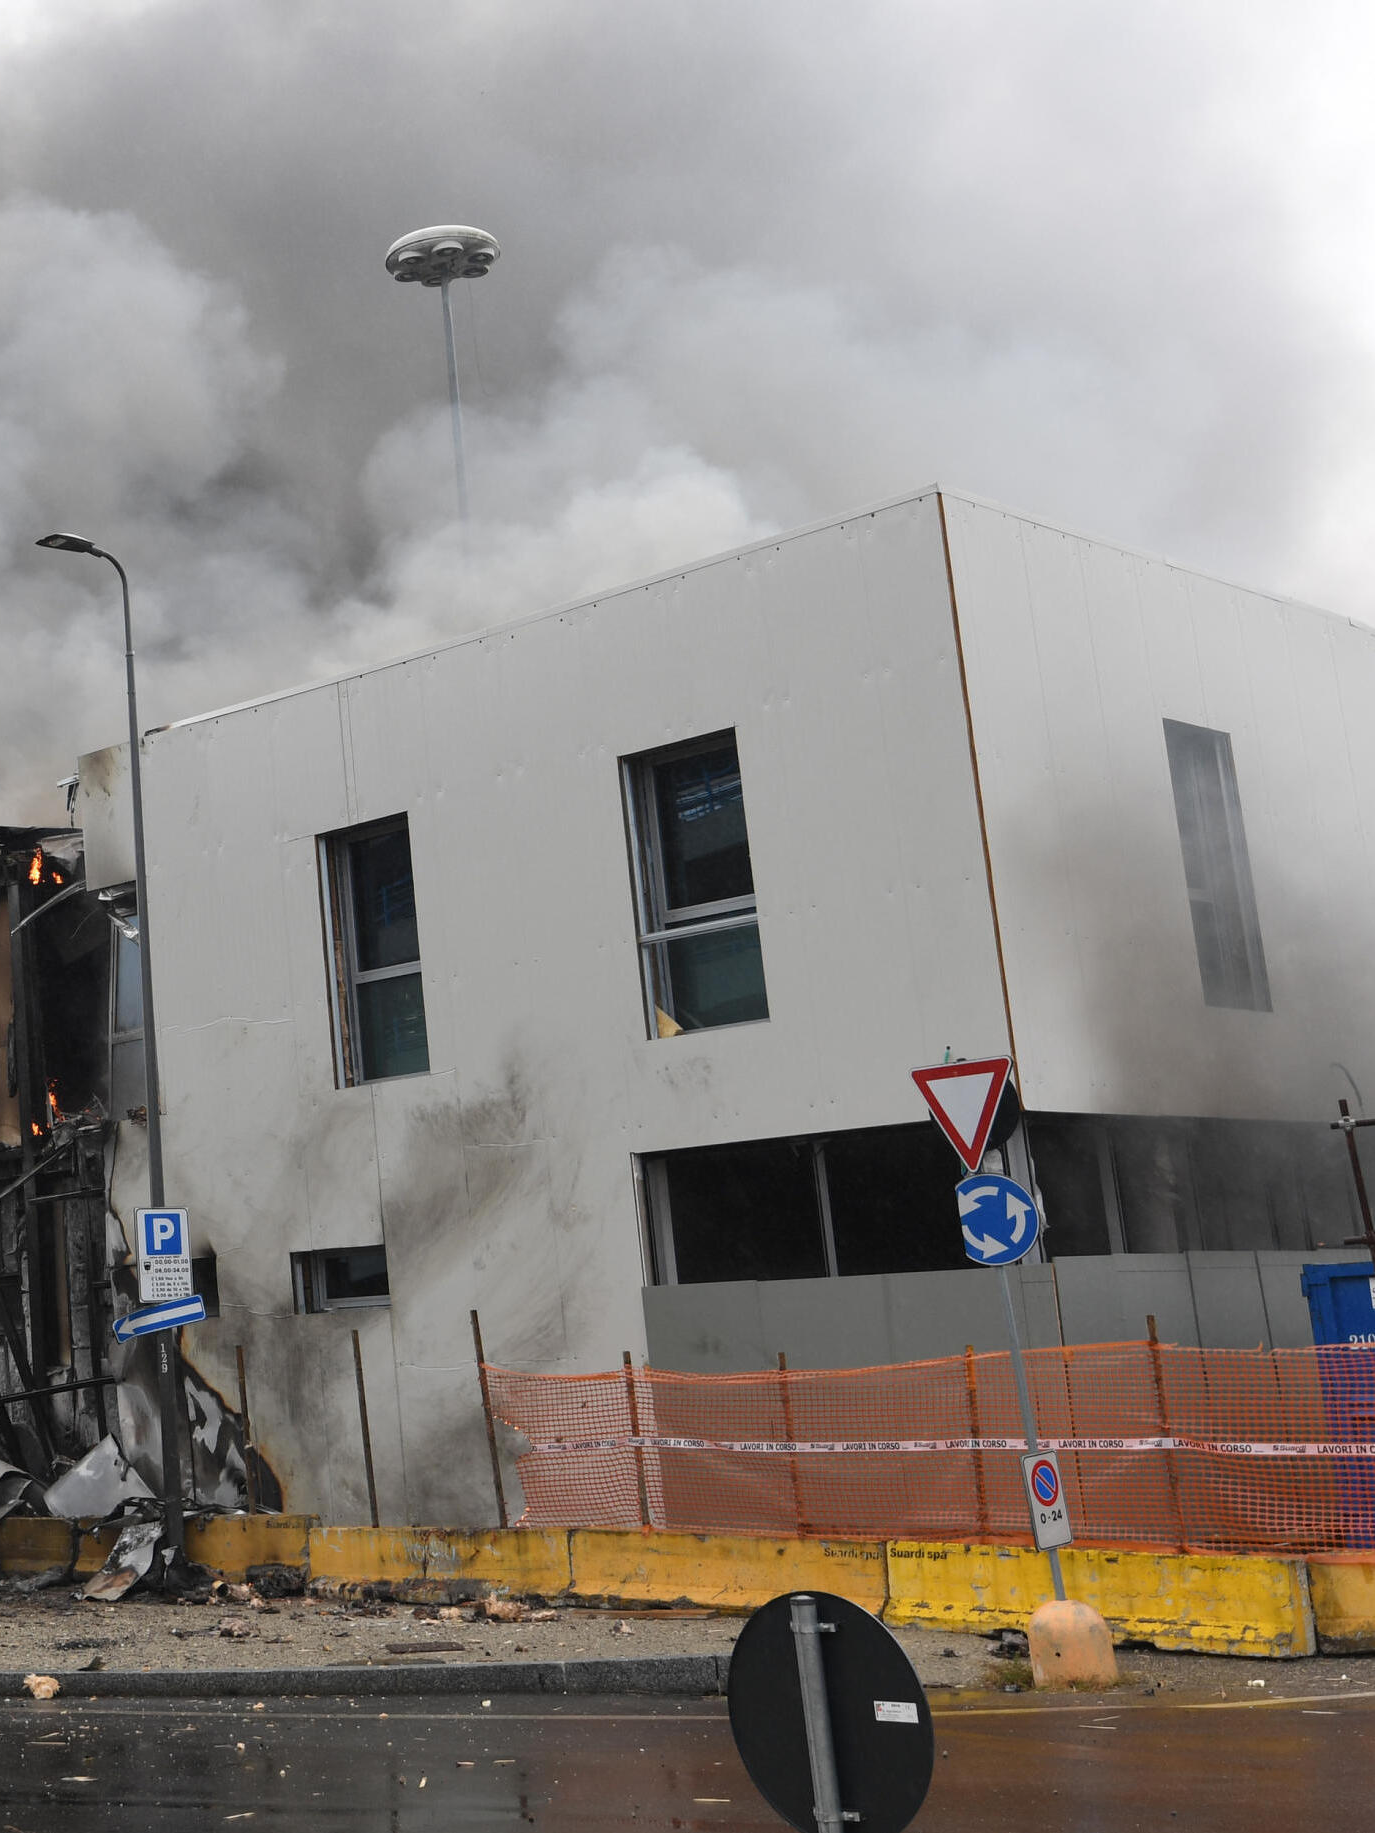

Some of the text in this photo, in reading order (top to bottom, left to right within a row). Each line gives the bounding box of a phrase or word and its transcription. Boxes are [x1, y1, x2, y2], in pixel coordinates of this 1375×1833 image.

[153, 1218, 175, 1250] P
[683, 1440, 705, 1448] CORSO
[766, 1443, 774, 1451] IN
[775, 1443, 797, 1451] CORSO
[841, 1442, 867, 1450] LAVORI
[868, 1442, 876, 1450] IN
[877, 1442, 900, 1450] CORSO
[944, 1440, 970, 1449] LAVORI
[971, 1440, 980, 1448] IN
[981, 1440, 1007, 1449] CORSO
[1058, 1440, 1087, 1448] LAVORI
[1088, 1440, 1097, 1448] IN
[1098, 1440, 1124, 1448] CORSO
[1172, 1439, 1206, 1450] LAVORI
[1208, 1443, 1218, 1452] IN
[1220, 1444, 1252, 1453] CORSO
[1317, 1445, 1353, 1454] LAVORI
[1355, 1445, 1367, 1454] IN
[890, 1547, 948, 1561] Suardi spa
